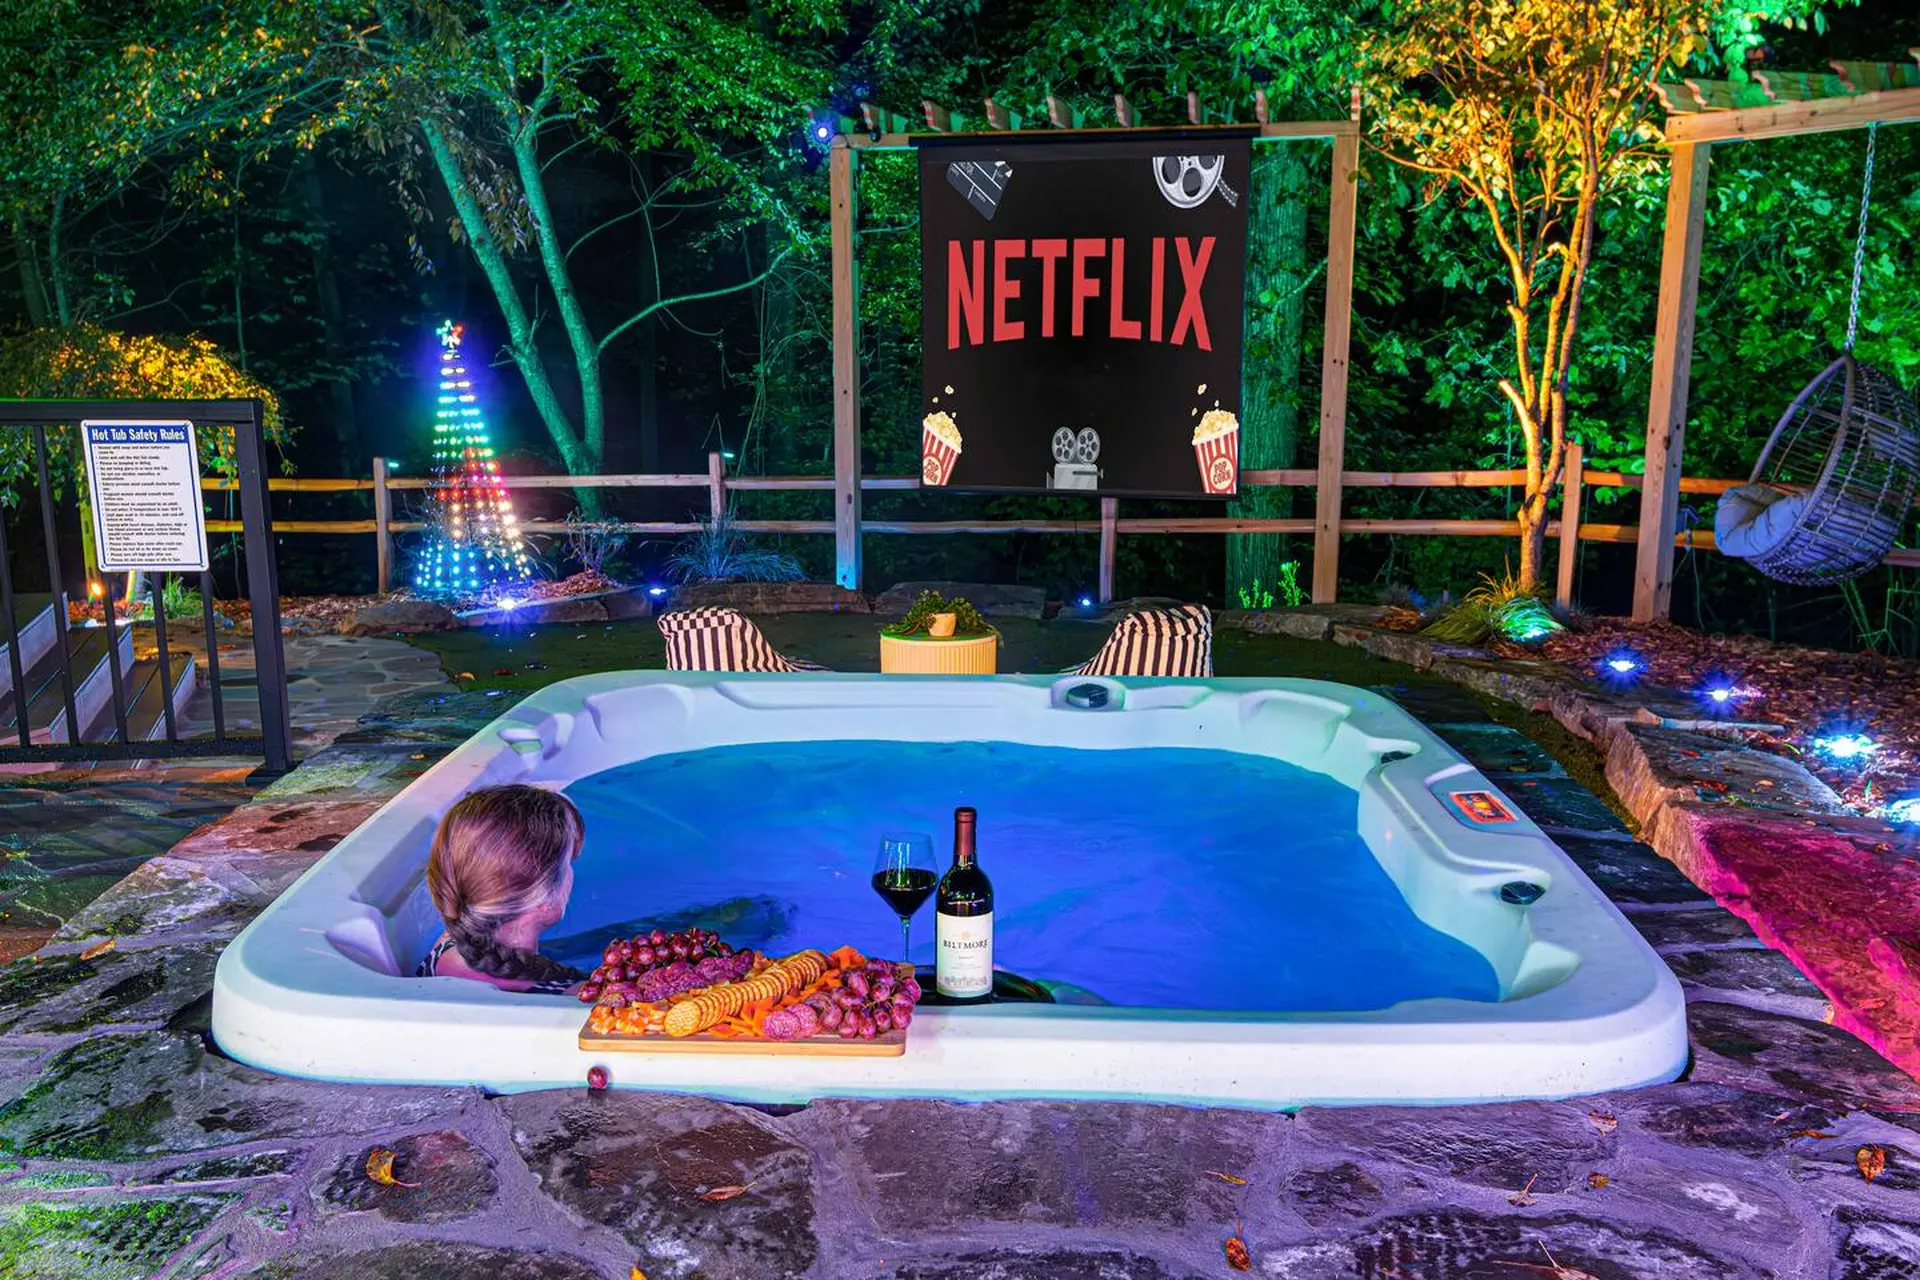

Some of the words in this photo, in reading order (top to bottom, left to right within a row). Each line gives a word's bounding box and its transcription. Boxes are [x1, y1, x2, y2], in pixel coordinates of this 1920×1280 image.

[947, 236, 1217, 351] NETFLIX
[91, 428, 109, 441] Hot
[110, 428, 127, 441] Tub
[129, 428, 158, 442] Safety
[159, 428, 185, 441] Rules
[943, 939, 988, 950] BILTMORE
